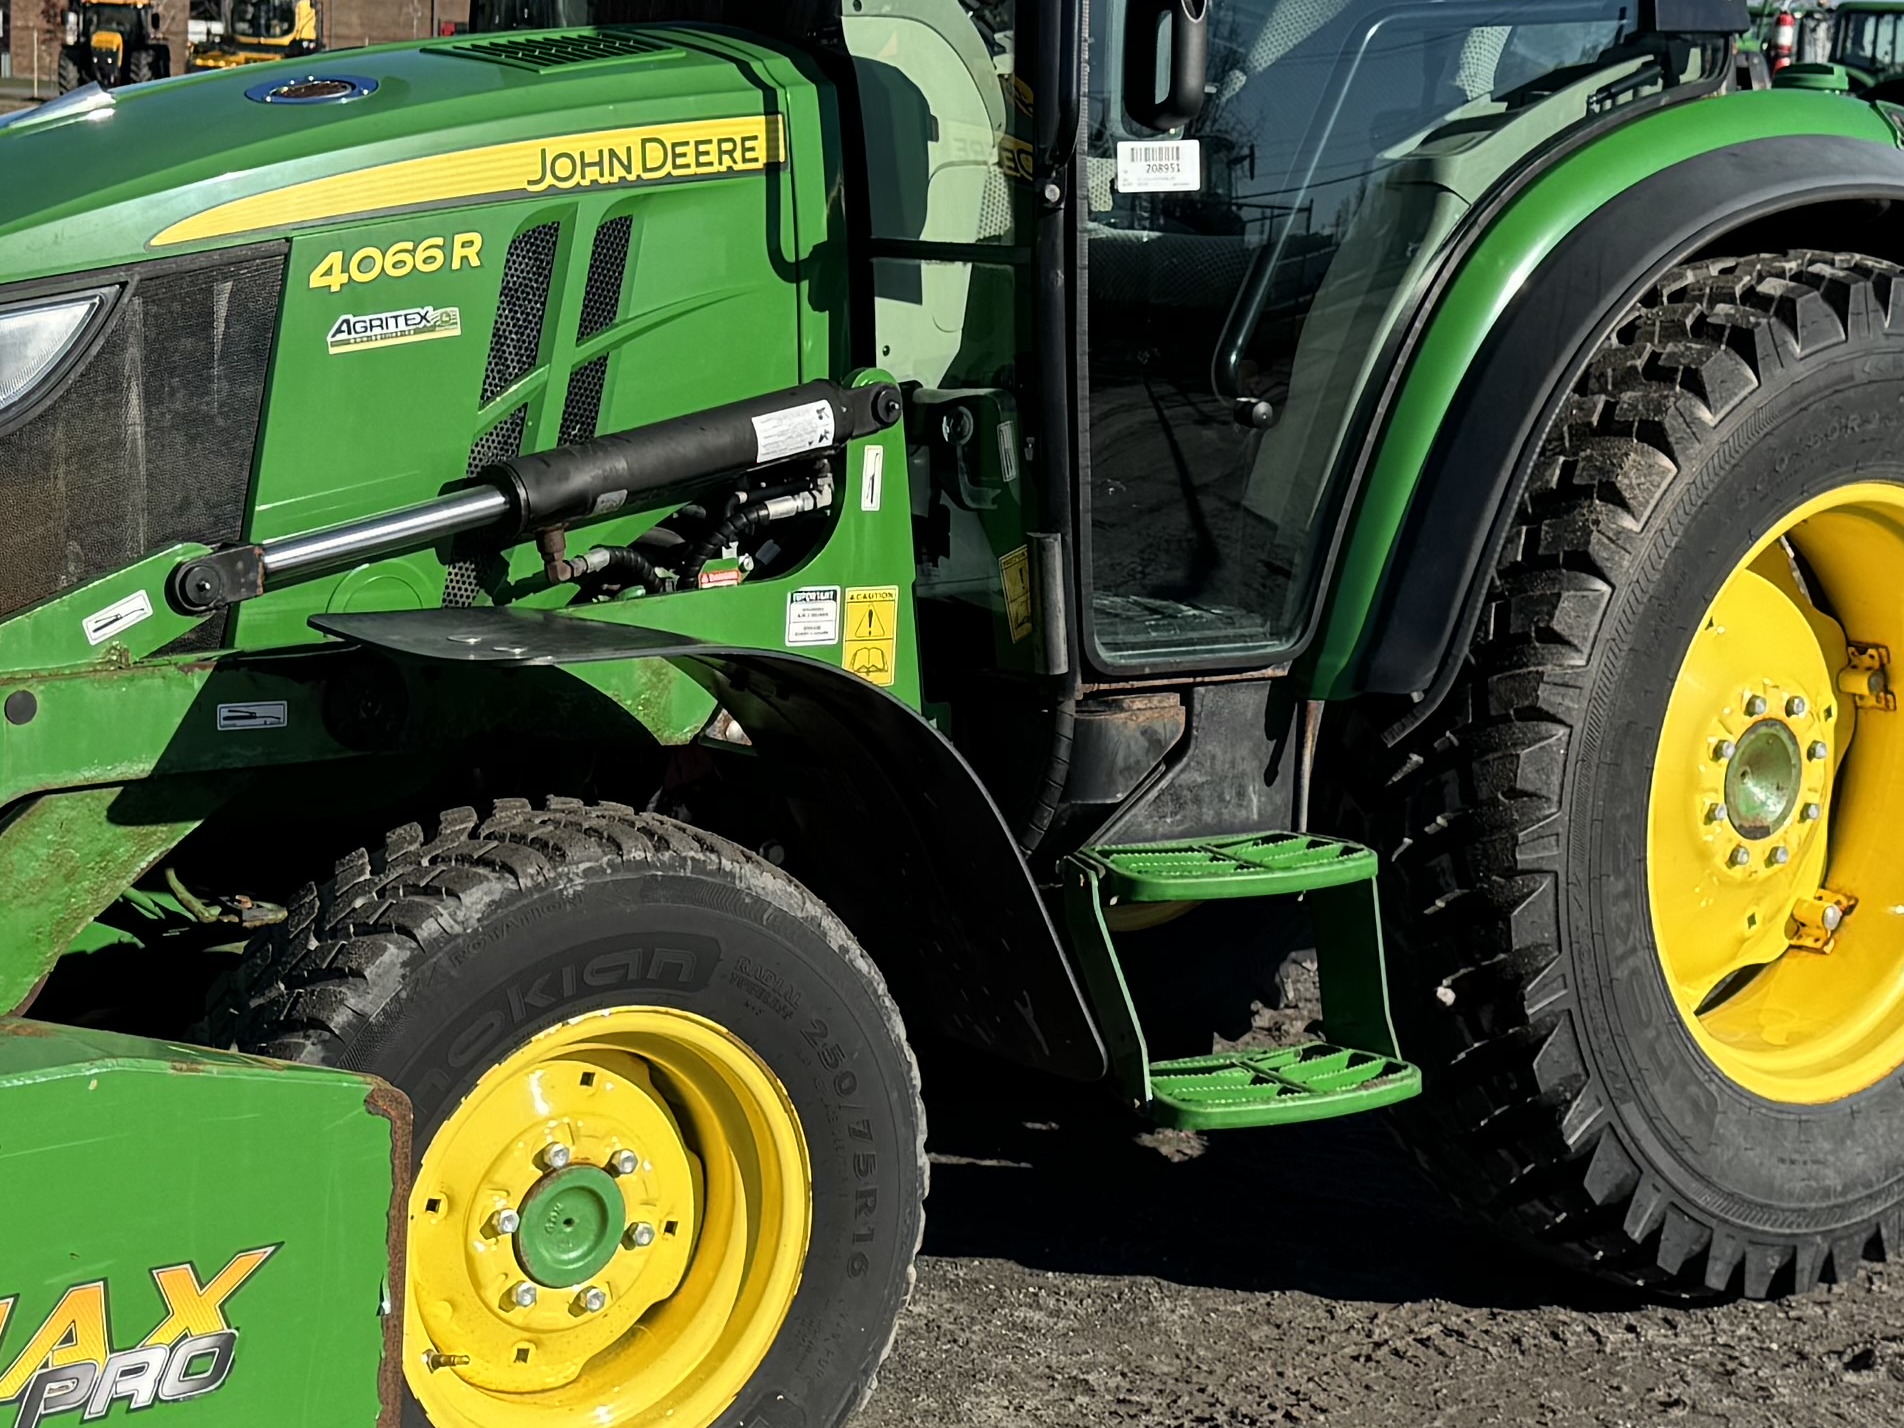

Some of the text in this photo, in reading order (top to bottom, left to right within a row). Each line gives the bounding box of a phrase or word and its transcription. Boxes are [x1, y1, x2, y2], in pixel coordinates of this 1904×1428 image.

[527, 134, 760, 188] JOHN DEERE
[329, 310, 432, 340] AGRITEX
[855, 591, 894, 601] CAUTION
